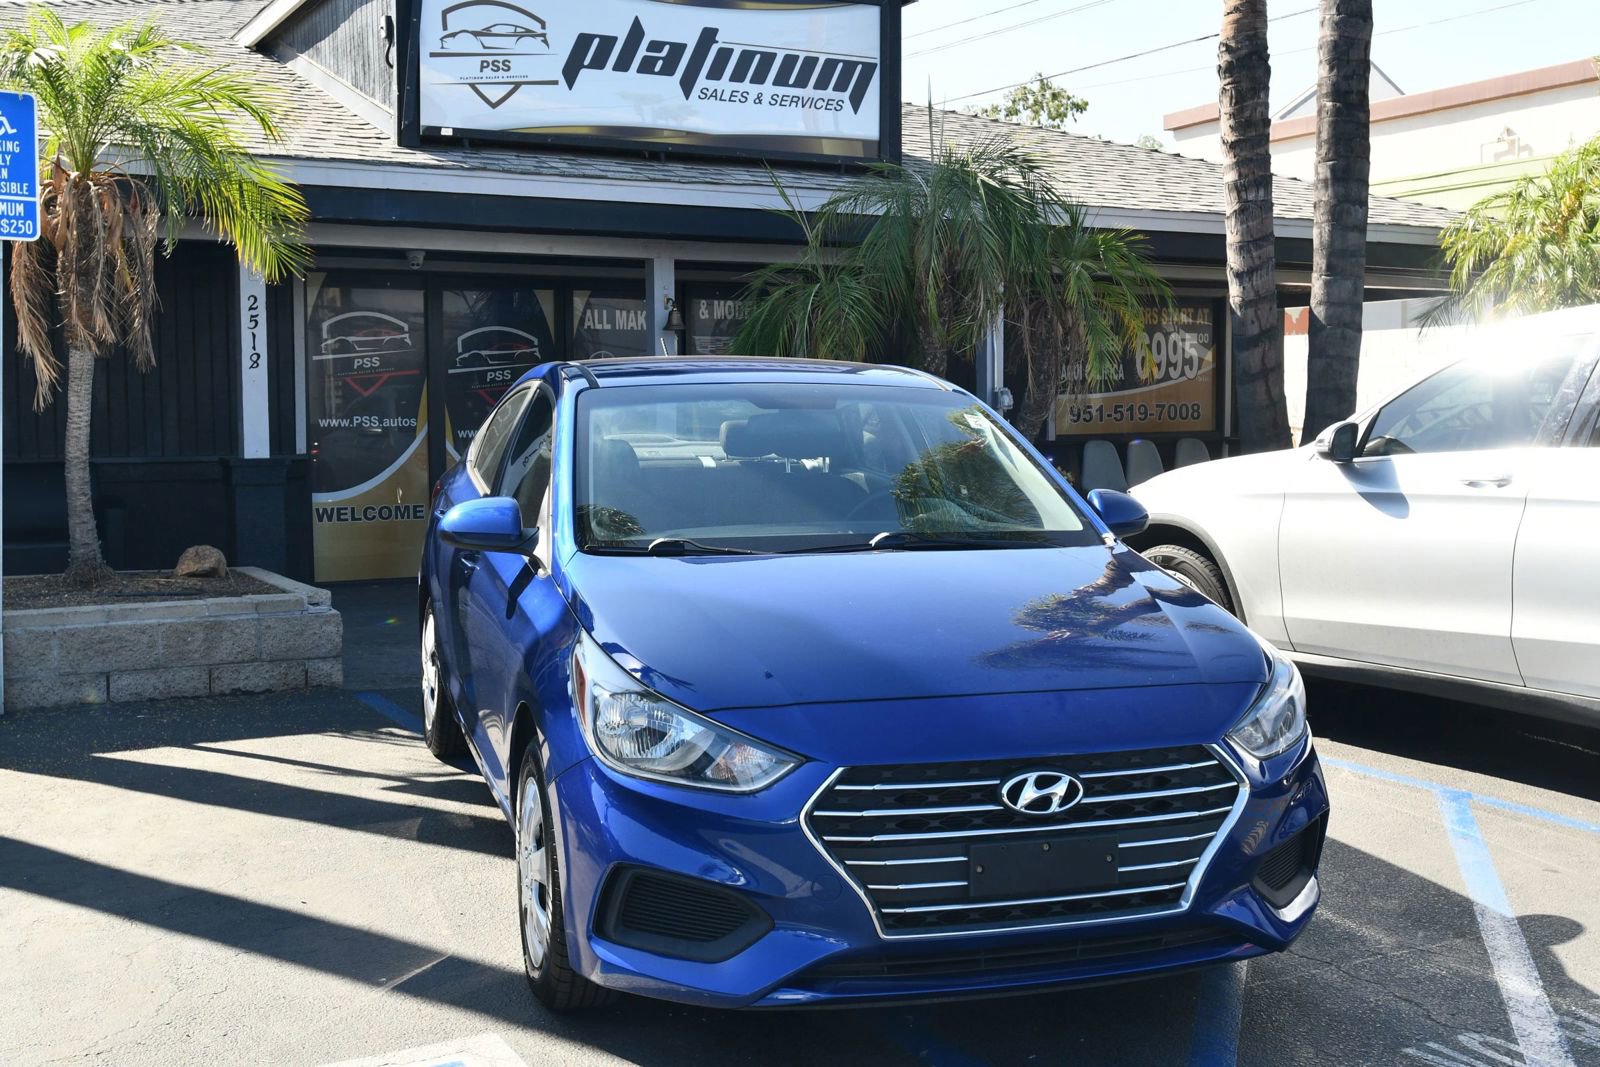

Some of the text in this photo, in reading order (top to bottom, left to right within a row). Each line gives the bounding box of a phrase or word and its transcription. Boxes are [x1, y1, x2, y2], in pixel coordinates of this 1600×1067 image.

[480, 59, 511, 73] PSS
[562, 16, 878, 115] platinum
[698, 87, 844, 112] SALES & SERVICES
[0, 181, 29, 195] SIBLE
[1, 219, 33, 235] $250
[699, 300, 709, 319] &
[1197, 307, 1209, 324] AT
[584, 309, 647, 331] ALL MAK
[247, 295, 261, 370] 2518
[354, 357, 380, 369] PSS
[1135, 332, 1199, 379] 6995
[486, 370, 512, 382] PSS
[318, 416, 417, 427] www.PSS.autos
[1069, 403, 1201, 424] 951-519-7008
[315, 504, 425, 524] WELCOME
